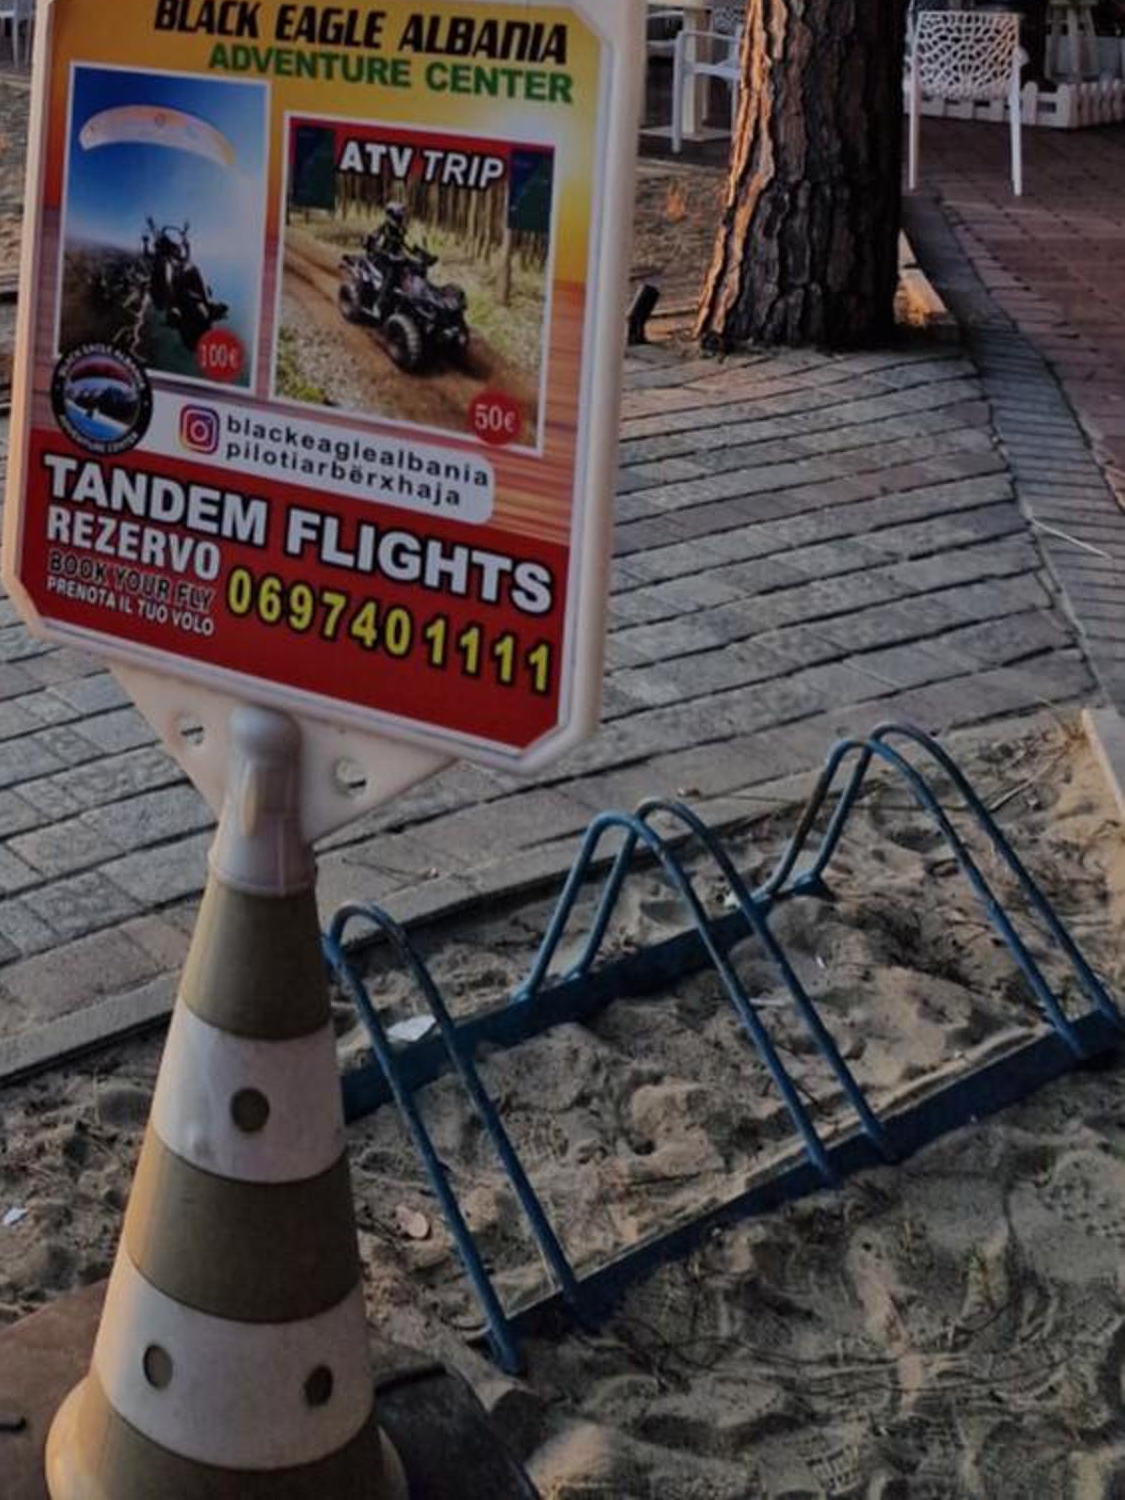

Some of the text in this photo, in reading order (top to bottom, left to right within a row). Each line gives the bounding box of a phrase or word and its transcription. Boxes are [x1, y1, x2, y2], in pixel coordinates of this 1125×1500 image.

[275, 3, 386, 50] EAGLE
[398, 13, 568, 66] ALBANIA
[208, 43, 573, 104] ADVENTURE CENTER
[339, 140, 504, 189] ATV TRIP
[474, 404, 515, 433] 50€
[226, 414, 489, 488] blackeaglealbania
[43, 452, 553, 615] TANDEM FLIGHTS
[47, 504, 220, 581] REZERVO
[47, 576, 214, 636] PRENOTA IL TUO VOLO
[48, 551, 215, 613] BOOK YOUR FLY
[228, 568, 550, 692] 0697401111
